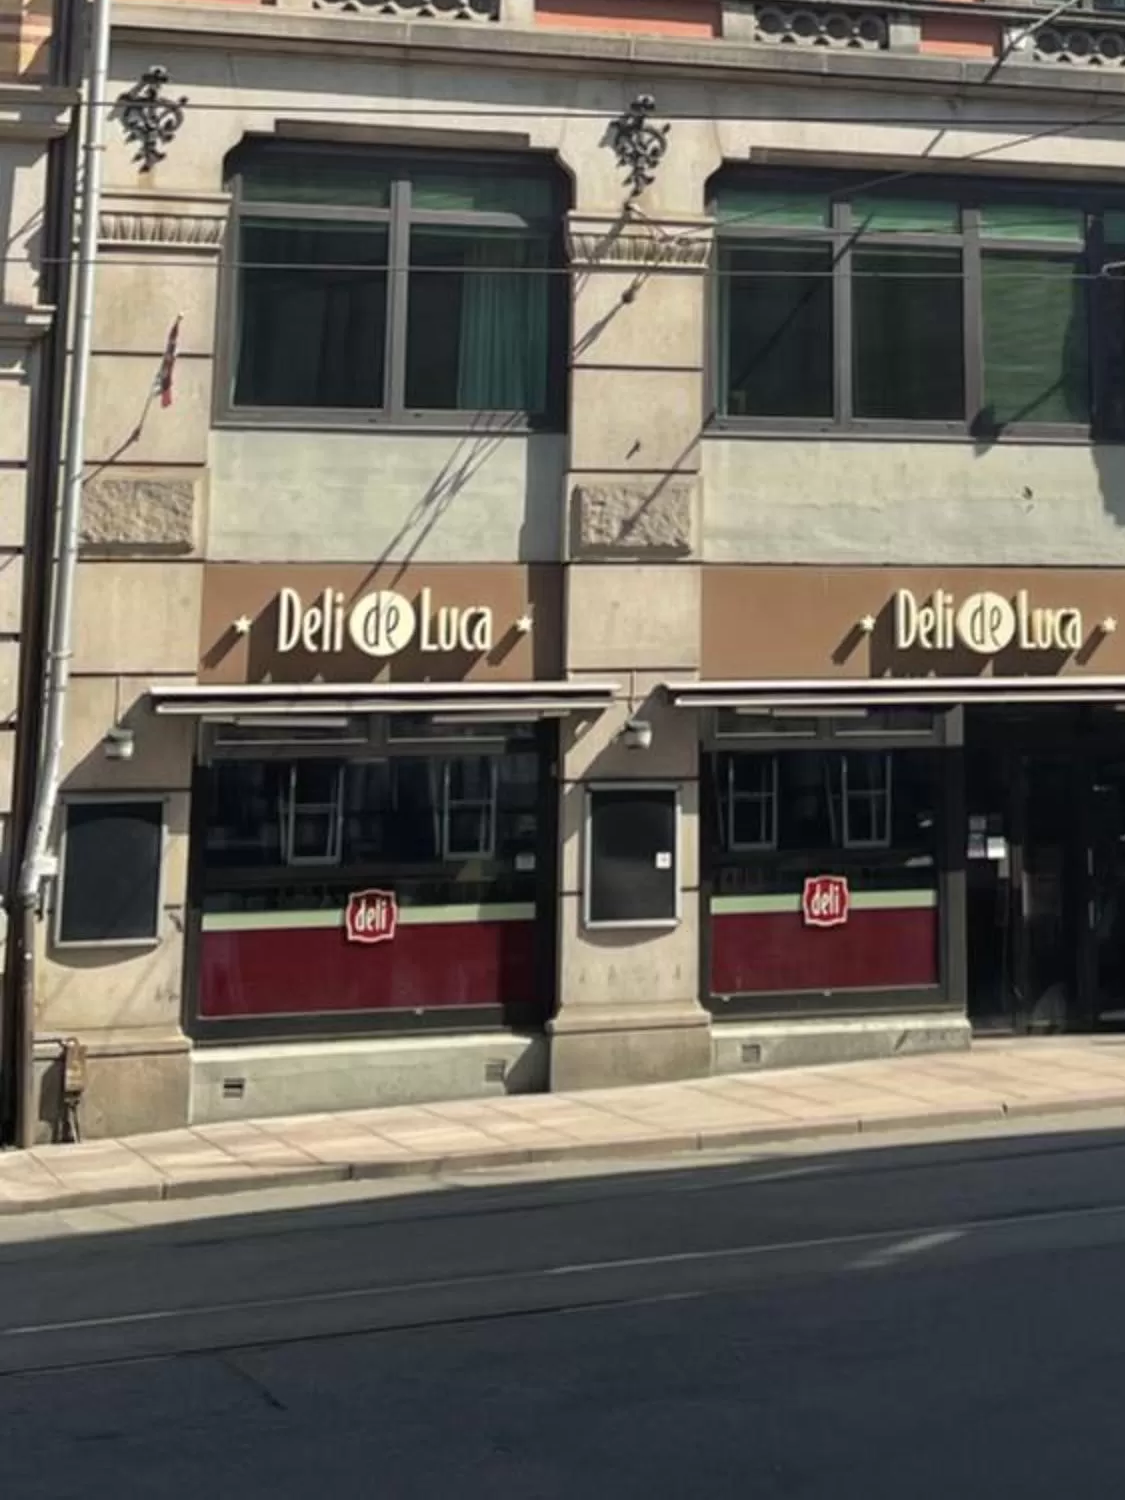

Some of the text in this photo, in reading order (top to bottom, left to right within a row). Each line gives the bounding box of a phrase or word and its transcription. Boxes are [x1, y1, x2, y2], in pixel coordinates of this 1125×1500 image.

[278, 587, 493, 653] Deli de Luca
[897, 588, 1083, 650] Deli de Luca
[354, 898, 387, 931] deli
[811, 883, 840, 916] deli
